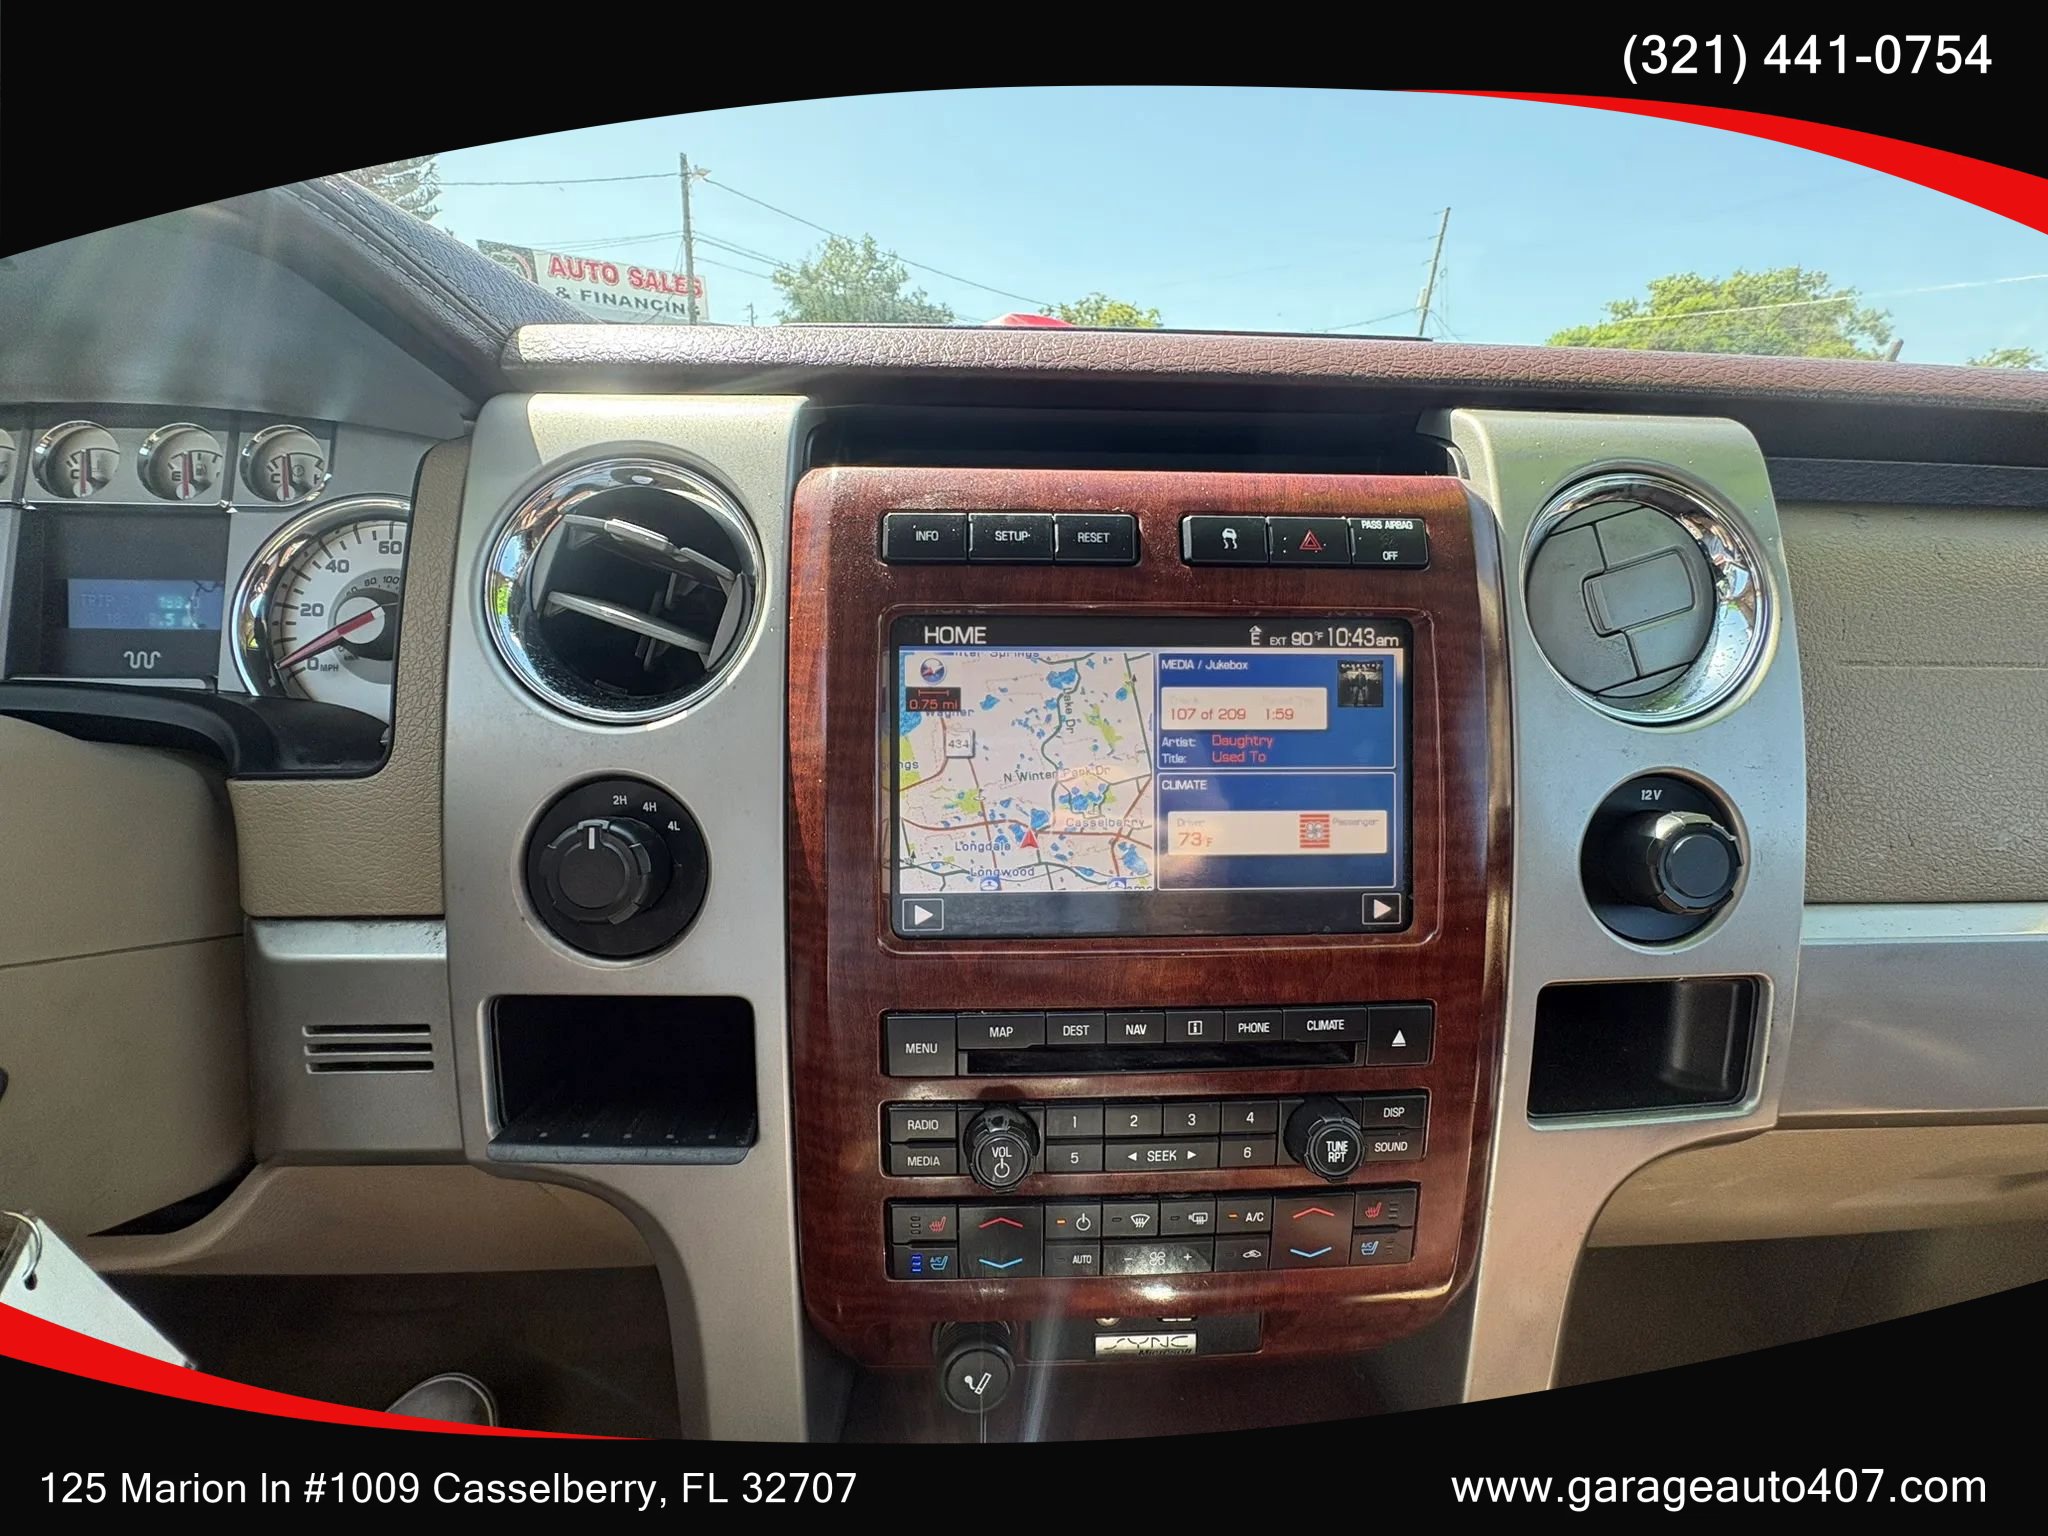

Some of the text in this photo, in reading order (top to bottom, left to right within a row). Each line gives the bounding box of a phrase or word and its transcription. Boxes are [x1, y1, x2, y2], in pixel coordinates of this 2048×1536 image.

[547, 253, 704, 298] AUTO SALES
[555, 286, 571, 300] &
[1361, 520, 1414, 530] PASS AIRBAG
[915, 530, 940, 542] INFO
[994, 530, 1029, 542] SETUP
[1077, 532, 1111, 544] RESET
[378, 540, 403, 555] 60
[1382, 551, 1399, 561] OFF
[325, 559, 350, 573] 40
[299, 603, 325, 617] 20
[924, 625, 988, 645] HOME
[1269, 636, 1287, 646] EXT
[320, 663, 340, 672] MPH
[1161, 659, 1195, 670] MEDIA
[1205, 659, 1249, 670] Jukebox
[909, 699, 939, 711] 0.75
[1170, 707, 1247, 721] 107 of 209
[1265, 707, 1295, 721] 1:59
[1161, 734, 1274, 749] Artist: Daughtry
[1161, 751, 1268, 764] Title: Used To
[1003, 772, 1014, 783] N
[1016, 769, 1059, 782] Winter
[1161, 779, 1208, 791] CLIMATE
[612, 794, 628, 806] 2H
[1640, 789, 1663, 801] 12V
[642, 801, 658, 813] 4H
[667, 820, 681, 832] 4L
[1178, 831, 1202, 847] 73
[1062, 1024, 1090, 1037] DEST
[1125, 1023, 1148, 1036] NAV
[1237, 1022, 1270, 1034] PHONE
[1306, 1019, 1345, 1032] CLIMATE
[989, 1026, 1014, 1038] MAP
[905, 1042, 939, 1054] MENU
[1246, 1111, 1255, 1124] 4
[1383, 1106, 1405, 1118] DISP
[907, 1119, 940, 1131] RADIO
[1129, 1114, 1139, 1127] 2
[1187, 1113, 1197, 1126] 3
[991, 1146, 1013, 1158] VOL
[1326, 1140, 1349, 1152] TUNE
[1374, 1141, 1408, 1153] SOUND
[1070, 1152, 1080, 1164] 5
[1146, 1150, 1177, 1163] SEEK
[1243, 1146, 1252, 1159] 6
[1327, 1151, 1346, 1163] RPT
[907, 1155, 941, 1167] MEDIA
[1245, 1211, 1265, 1223] A/C
[1072, 1254, 1092, 1265] AUTO
[1103, 1335, 1189, 1351] SYNC
